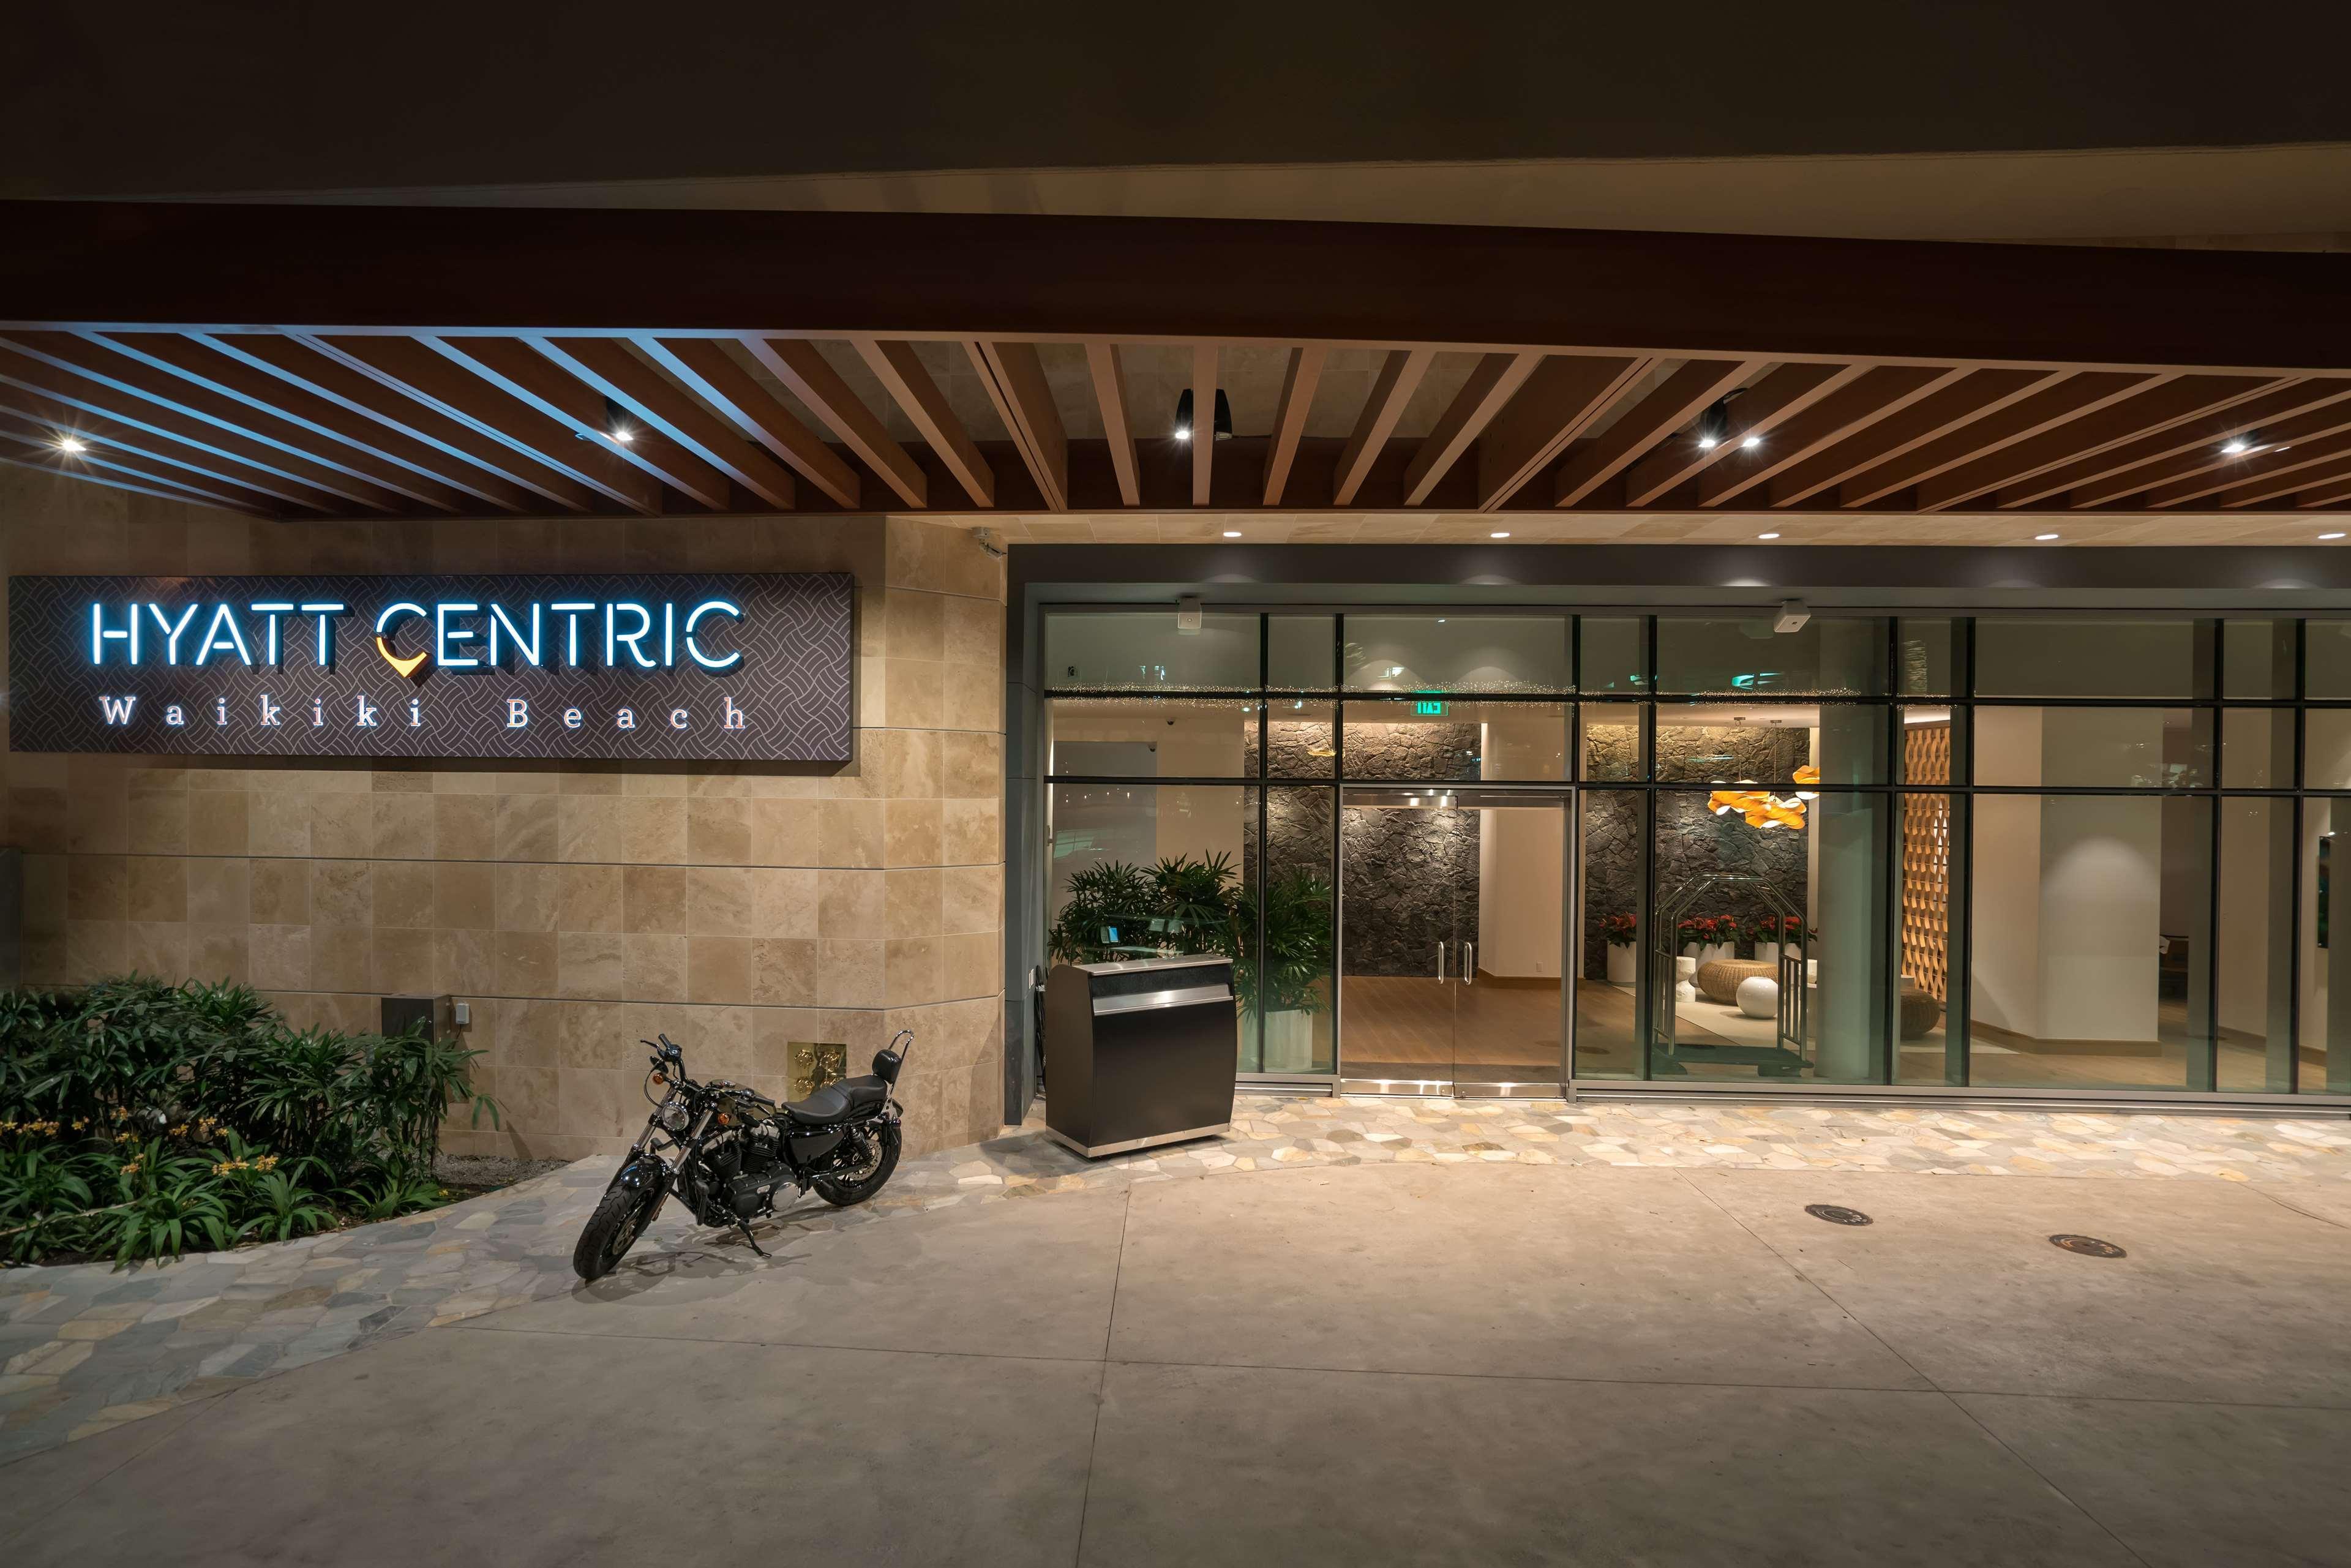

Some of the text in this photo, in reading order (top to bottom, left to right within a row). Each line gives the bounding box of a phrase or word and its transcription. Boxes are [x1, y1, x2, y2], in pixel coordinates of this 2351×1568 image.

[93, 601, 740, 678] HYATT CENTRIC
[99, 694, 746, 729] Waikiki Beach
